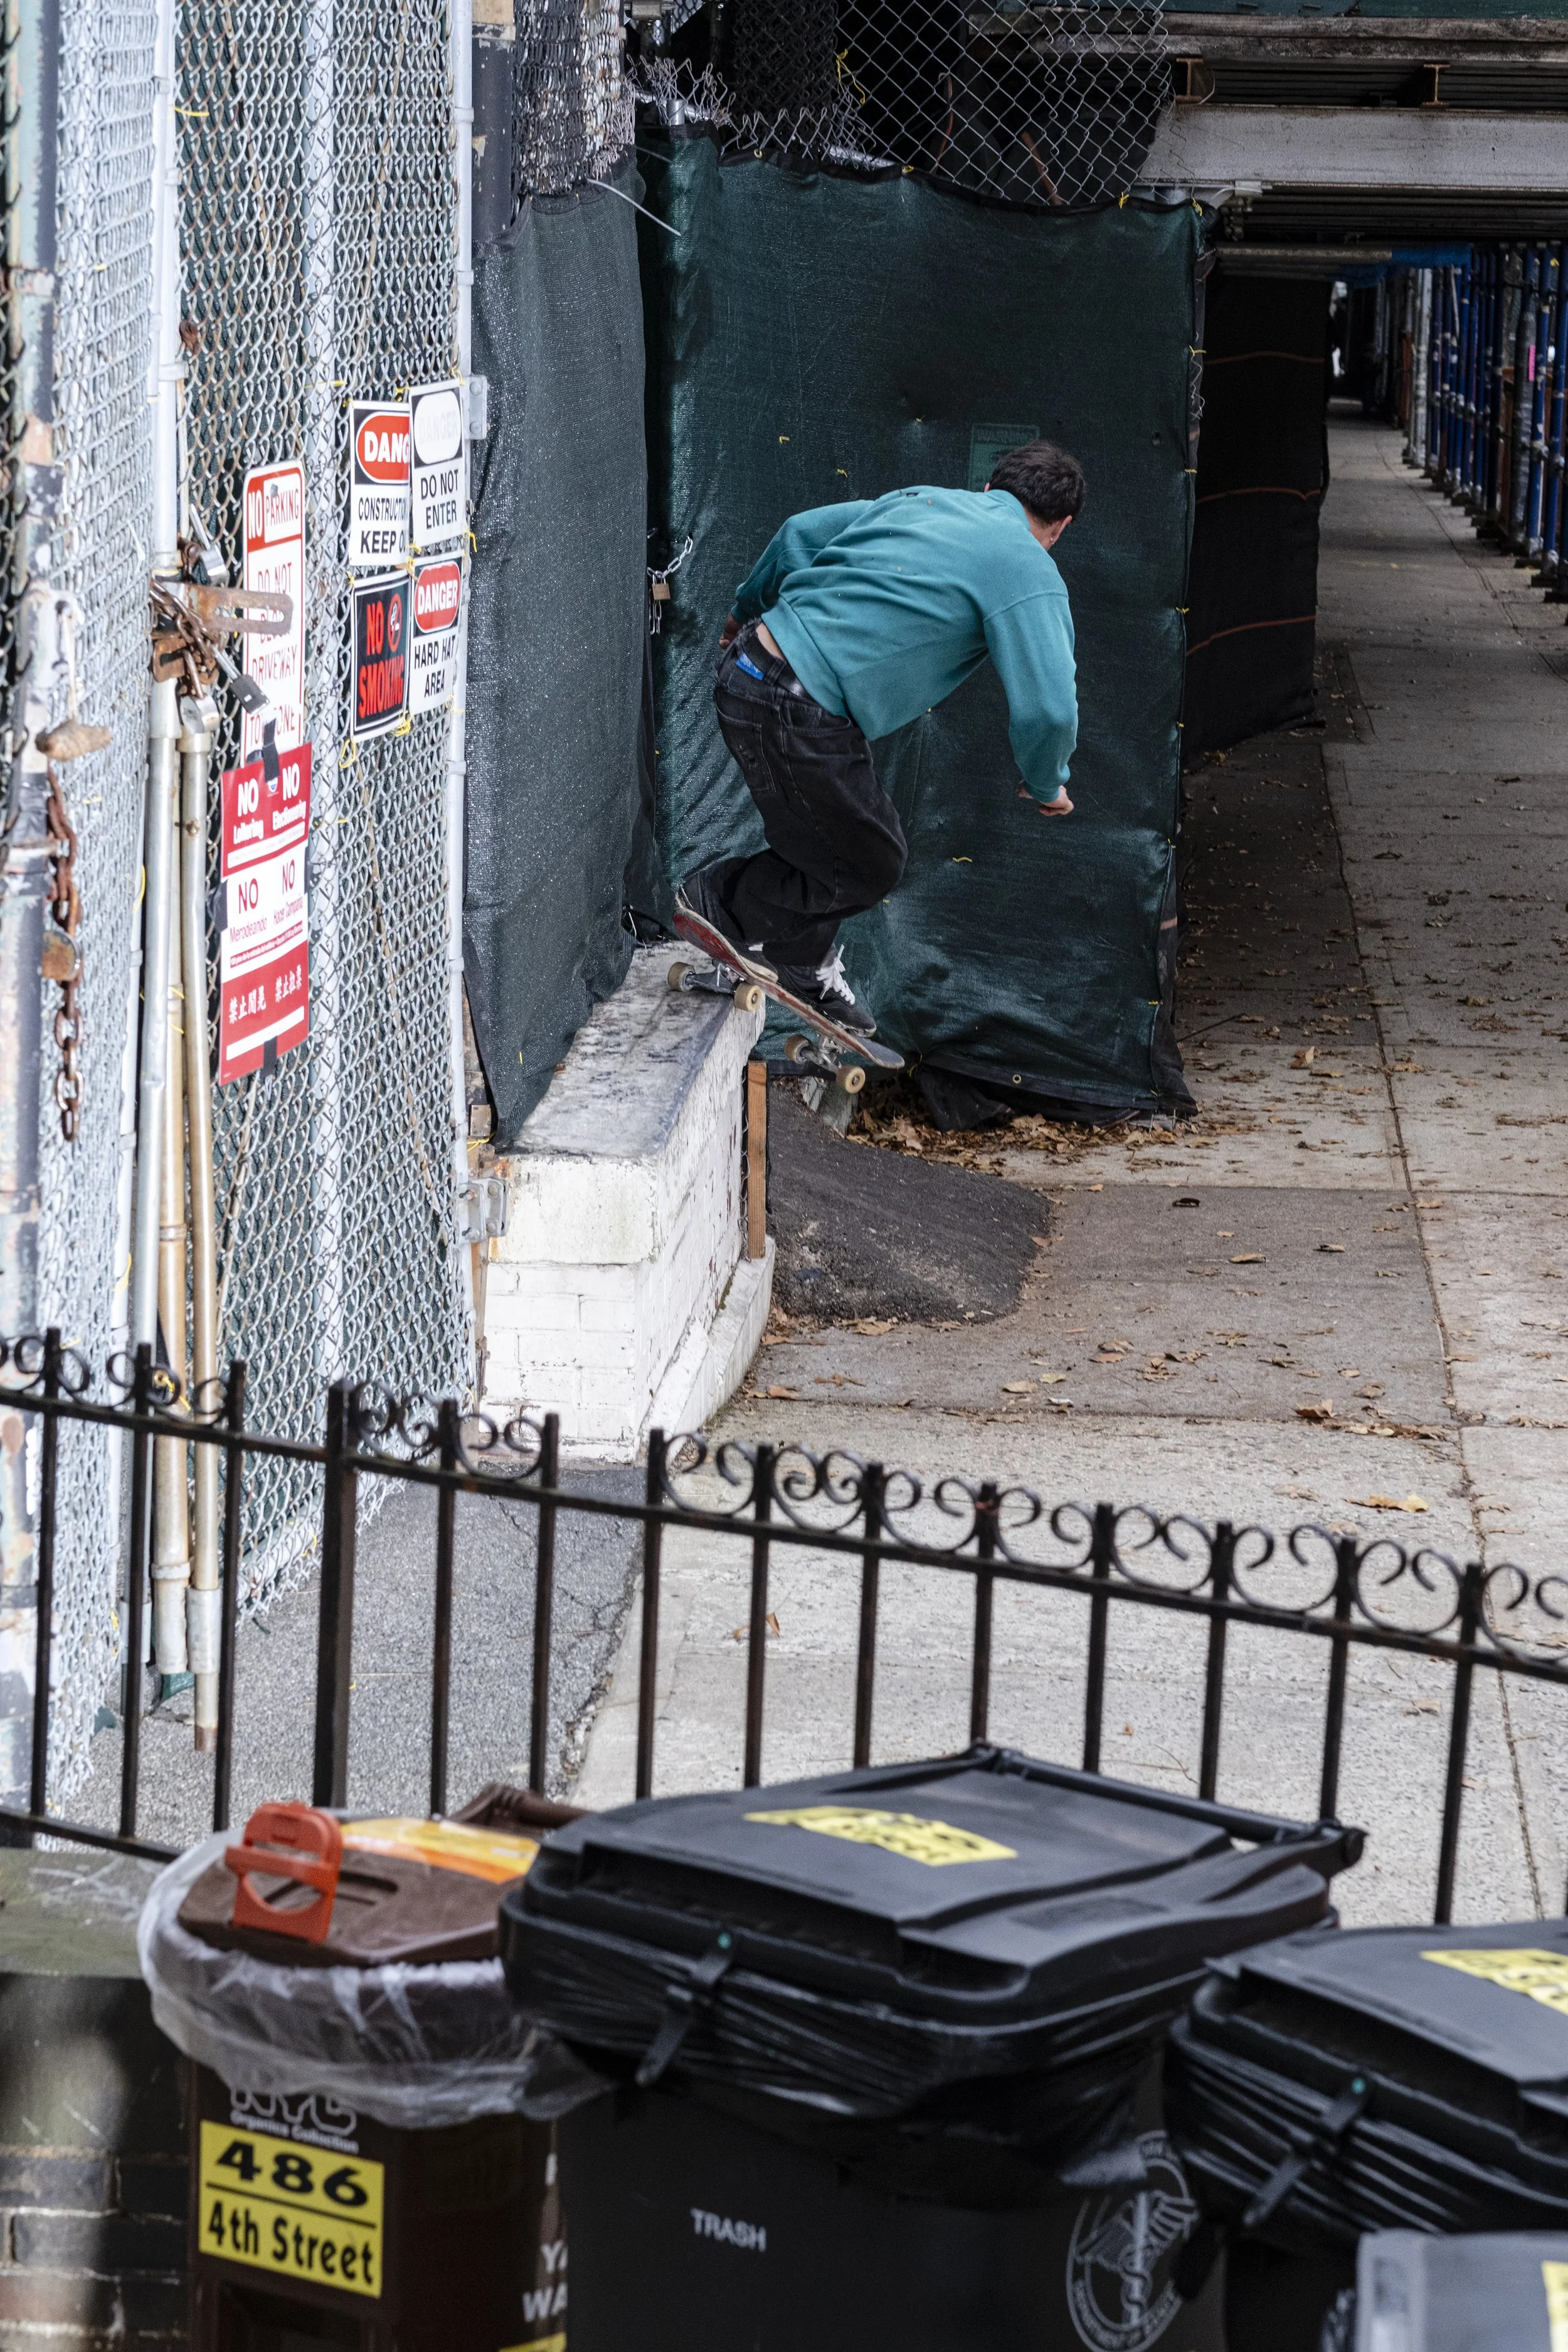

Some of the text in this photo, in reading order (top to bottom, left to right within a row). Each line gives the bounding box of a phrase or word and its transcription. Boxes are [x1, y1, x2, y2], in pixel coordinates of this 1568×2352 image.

[364, 431, 410, 464] DANG
[421, 469, 459, 500] DO NOT
[248, 488, 299, 539] NO PARKING
[426, 499, 457, 530] ENTER
[360, 530, 396, 554] KEEP
[275, 562, 292, 595] NOT
[418, 579, 458, 615] DANGER
[366, 600, 384, 656] NO
[252, 644, 297, 687] DRIVEWAY
[414, 635, 456, 670] HARD HAT
[358, 654, 405, 719] SMOKING
[424, 668, 445, 698] AREA
[250, 704, 295, 746] TO ONE
[238, 778, 259, 817] NO
[282, 763, 300, 801] NO
[233, 818, 264, 845] Loitering
[282, 859, 295, 895] NO
[238, 878, 258, 914] NO
[230, 915, 268, 944] Merodeando
[216, 2139, 369, 2208] 486
[208, 2201, 374, 2286] 4th Street
[691, 2208, 766, 2252] TRASH
